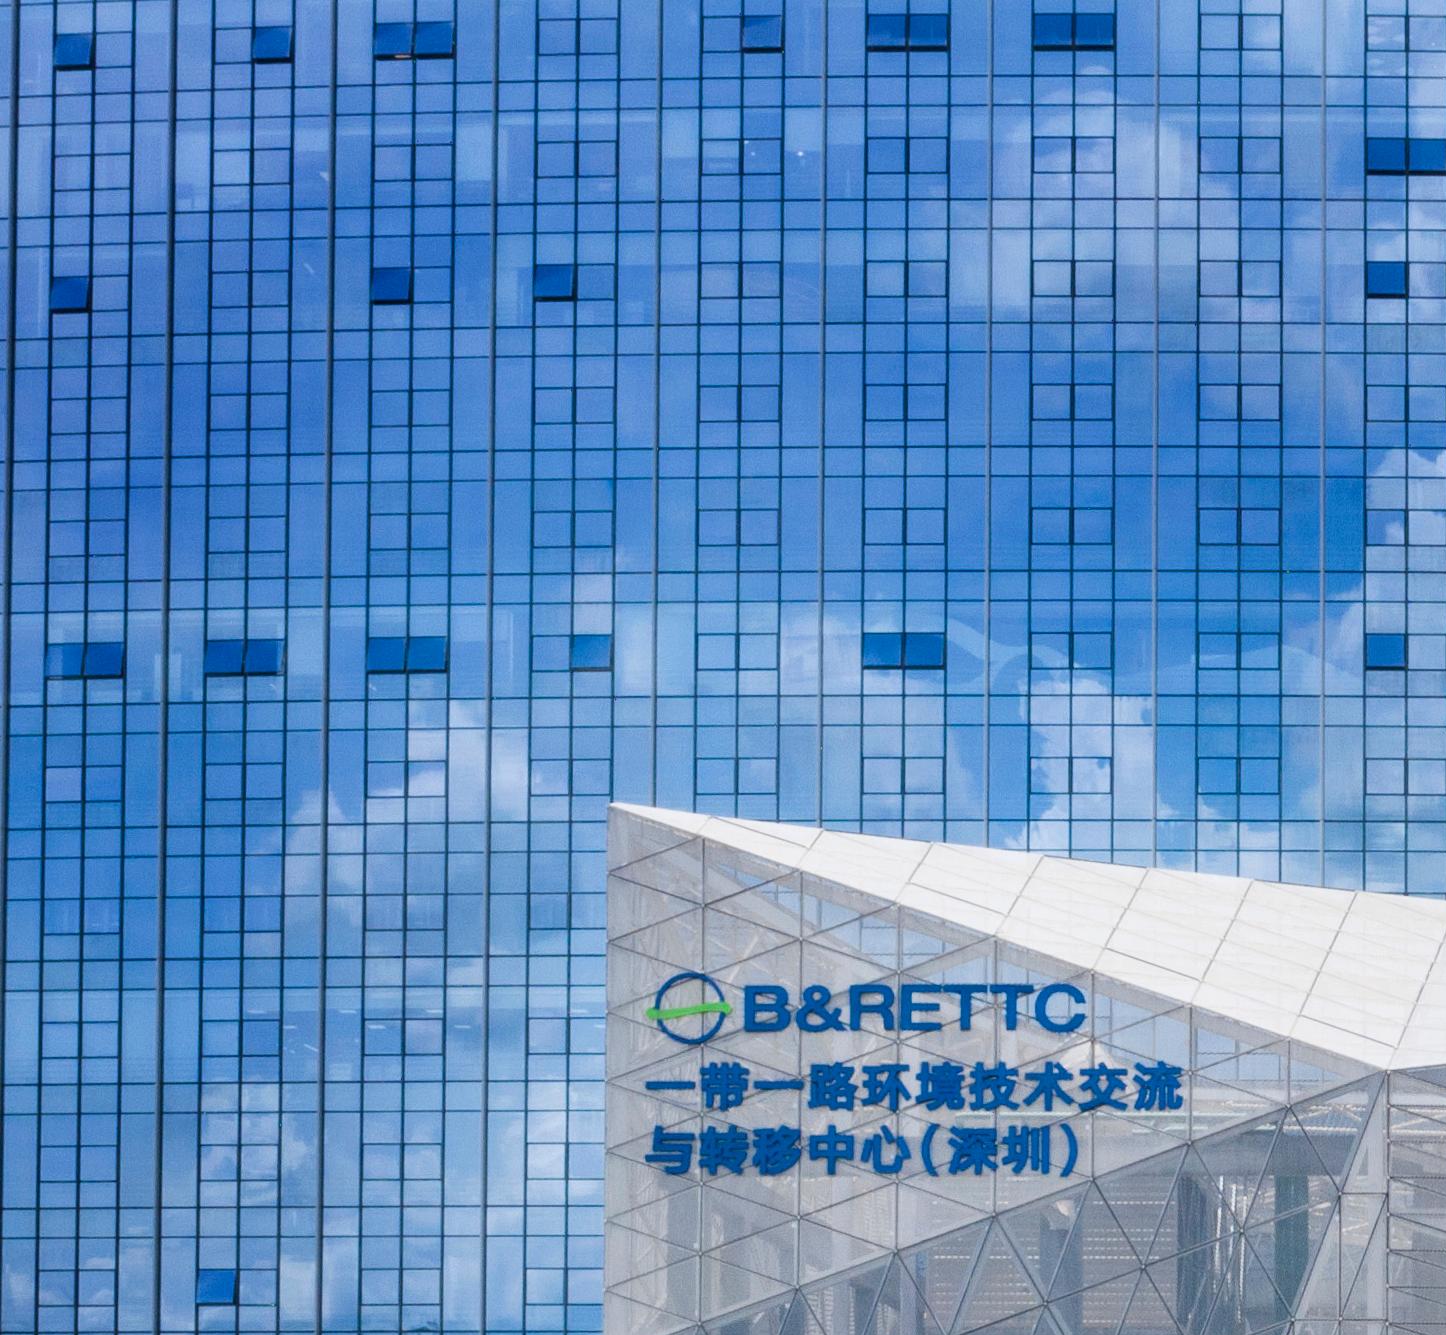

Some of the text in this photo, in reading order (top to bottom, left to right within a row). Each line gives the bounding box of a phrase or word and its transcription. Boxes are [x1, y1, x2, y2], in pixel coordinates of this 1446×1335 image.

[743, 983, 1087, 1034] B&RETTC
[645, 1060, 1184, 1112] 一带一路环境技术交流
